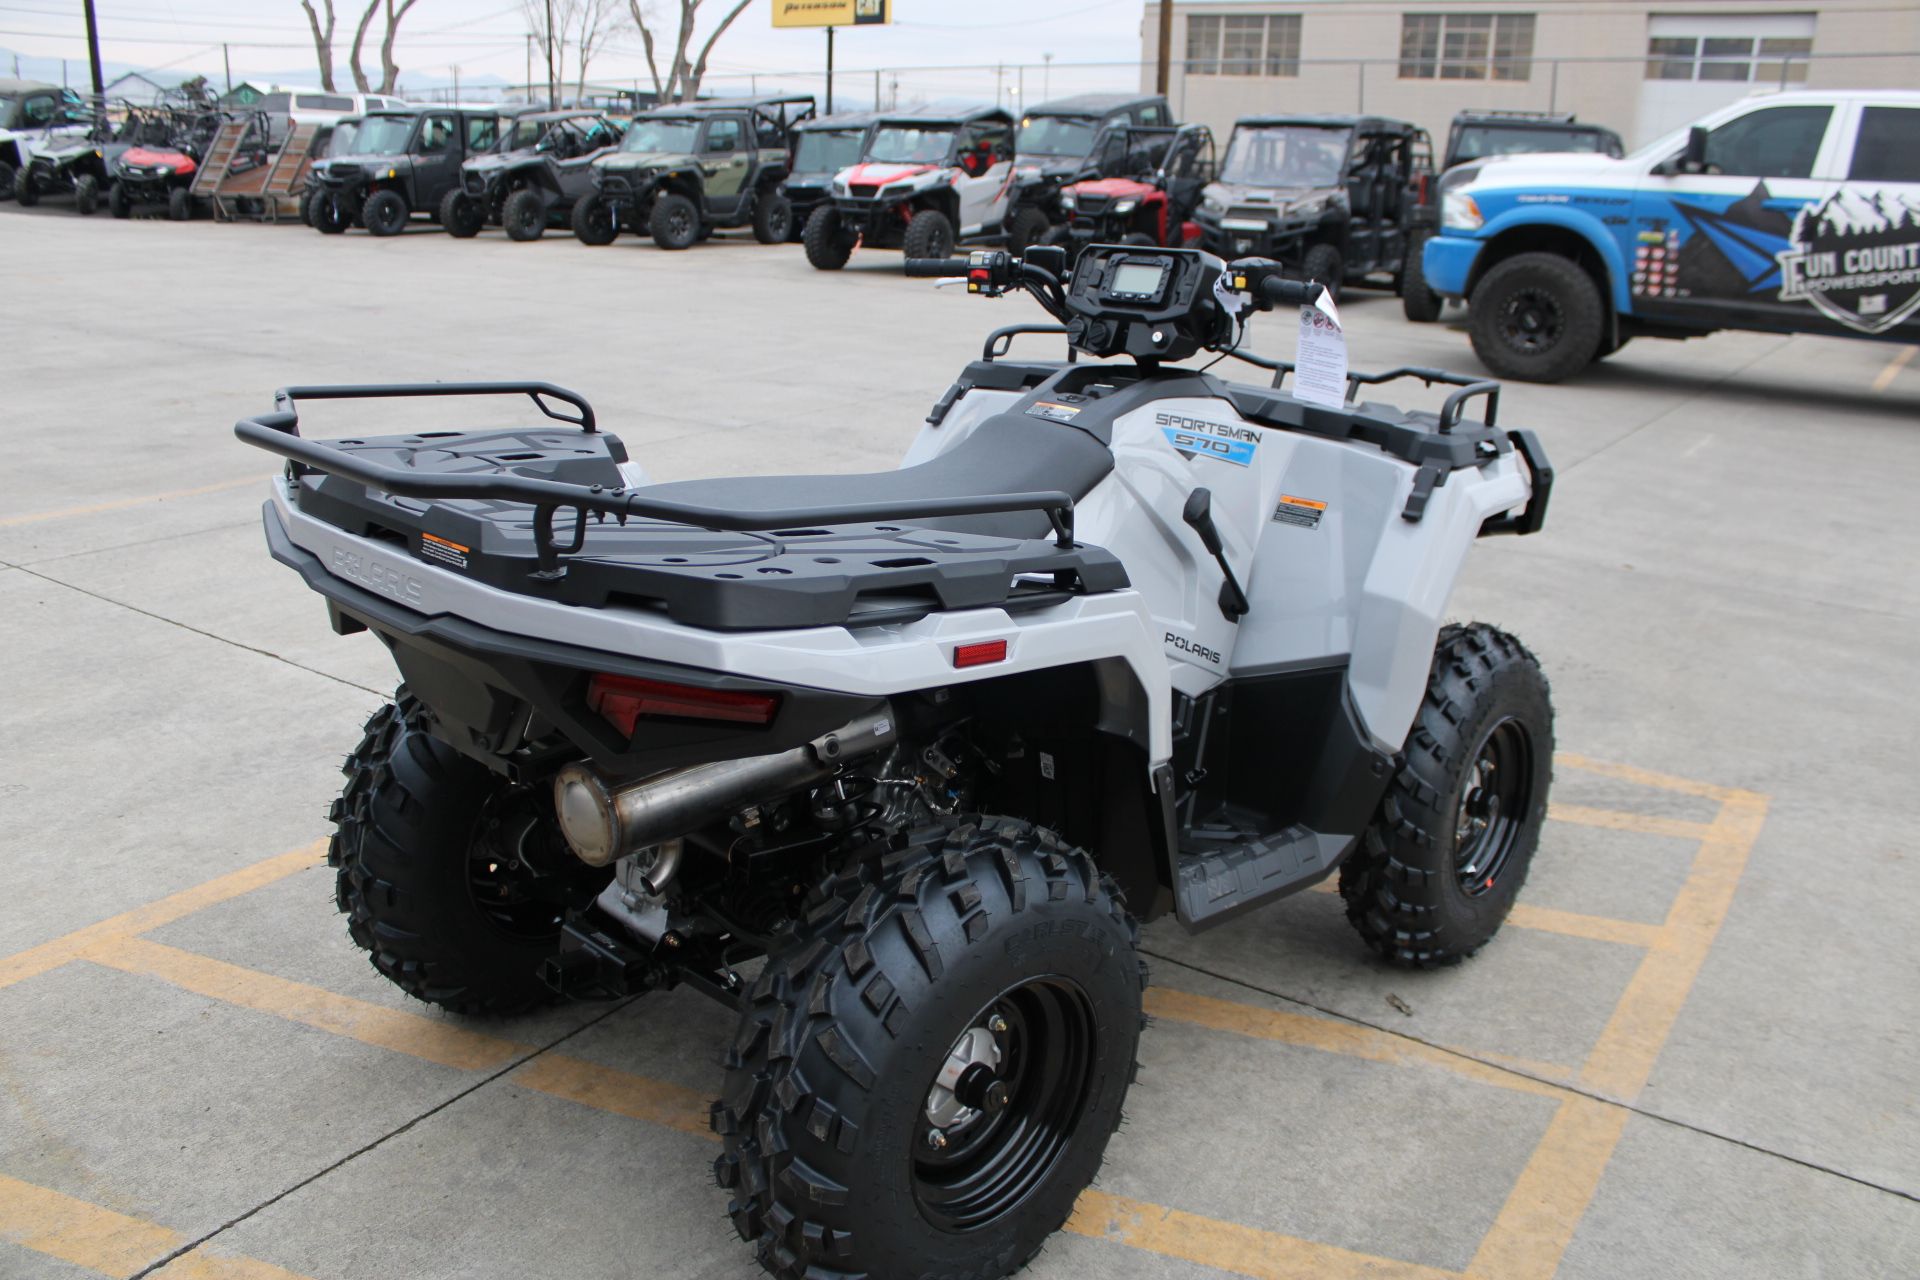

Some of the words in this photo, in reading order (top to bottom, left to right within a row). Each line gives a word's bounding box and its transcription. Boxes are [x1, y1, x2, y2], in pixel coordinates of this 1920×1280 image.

[1775, 250, 1837, 299] FUN
[1155, 412, 1262, 444] SPORTSMAN
[1174, 433, 1230, 453] 570
[332, 545, 422, 606] POLARIS
[1164, 631, 1221, 664] POLARIS
